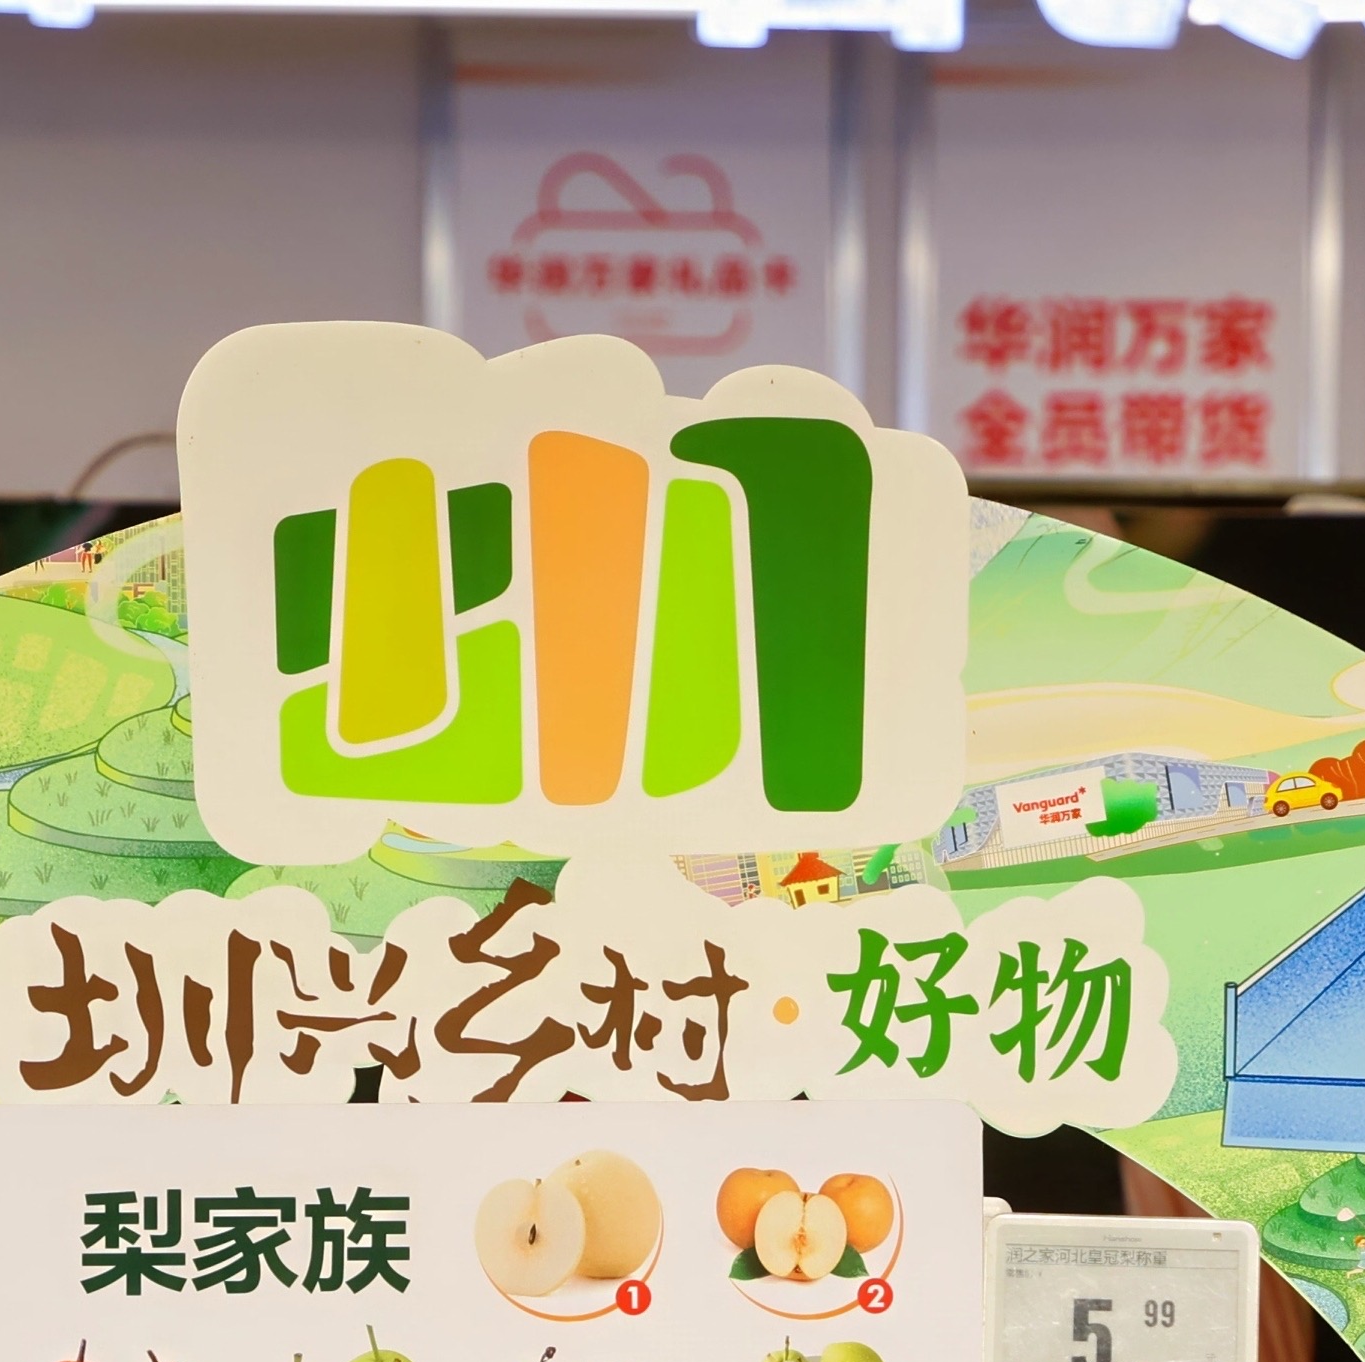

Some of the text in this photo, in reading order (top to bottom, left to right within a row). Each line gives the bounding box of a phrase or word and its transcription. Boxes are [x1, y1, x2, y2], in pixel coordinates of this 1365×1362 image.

[959, 297, 1276, 378] 华润万家
[959, 390, 1274, 470] 全员带货
[1012, 793, 1081, 814] Vanguard
[1039, 808, 1082, 825] 华润万家
[79, 1185, 412, 1298] 梨家族
[1006, 1246, 1168, 1267] 润之家河北皇冠梨称重
